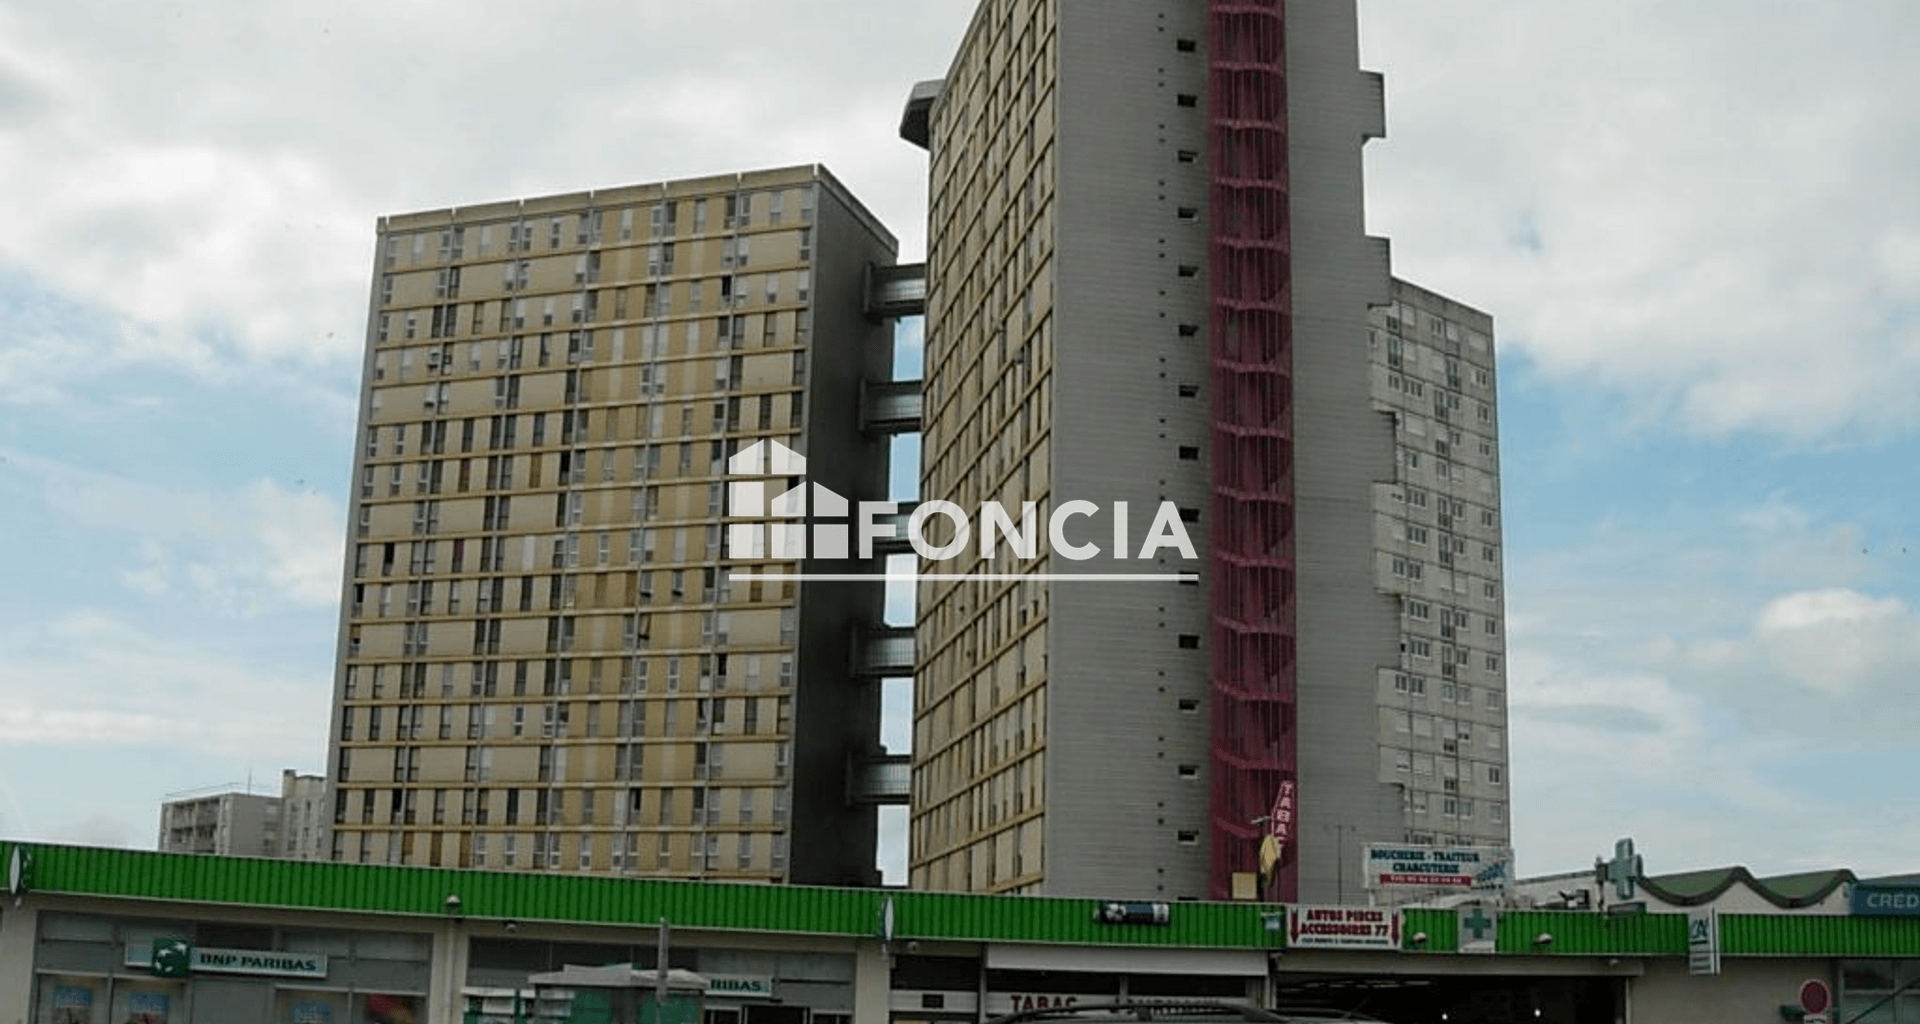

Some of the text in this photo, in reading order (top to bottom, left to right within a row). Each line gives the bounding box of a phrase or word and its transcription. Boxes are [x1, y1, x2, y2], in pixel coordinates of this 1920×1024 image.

[1371, 849, 1480, 862] BOUCHERIE TRAITEUR
[1374, 925, 1389, 936] 77
[200, 953, 316, 972] BNP PARIBAS
